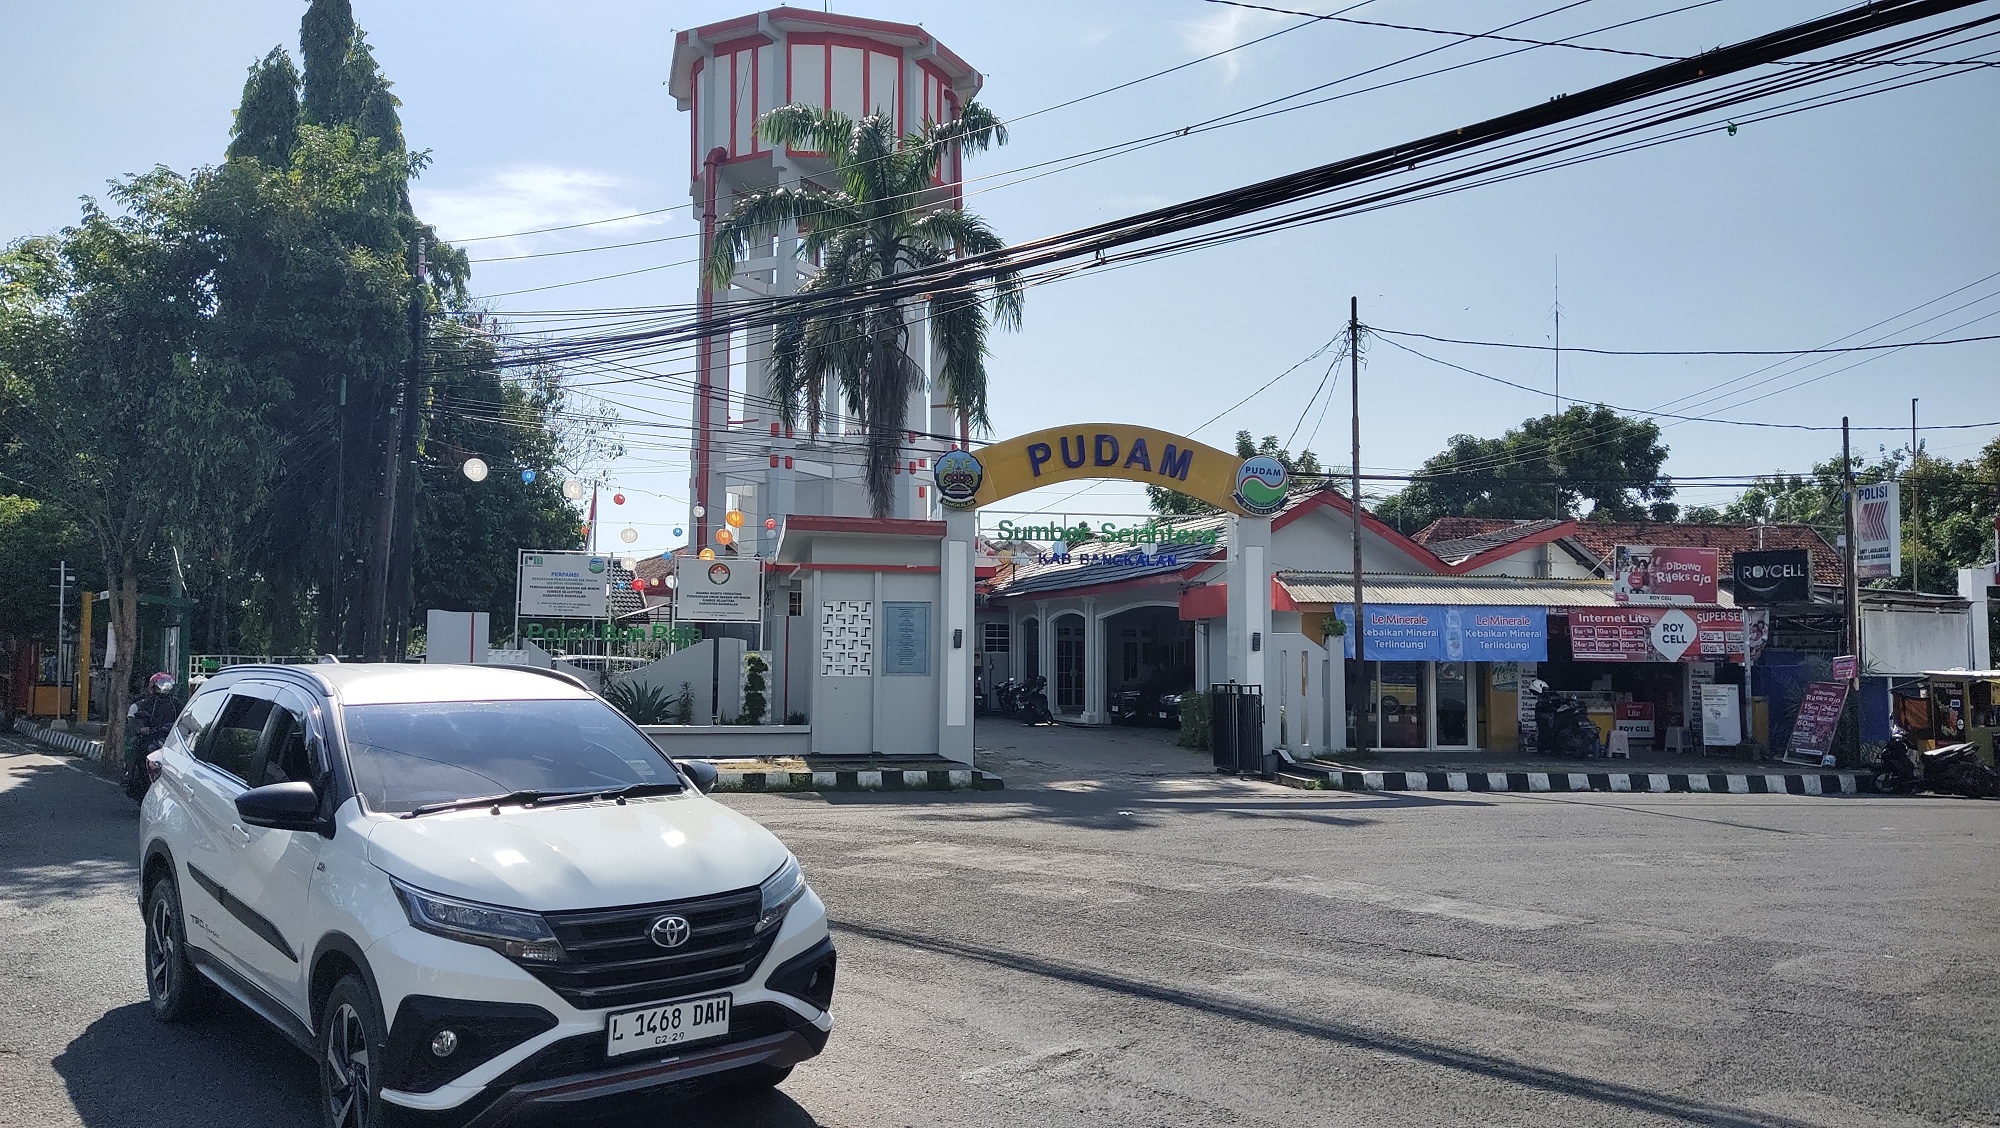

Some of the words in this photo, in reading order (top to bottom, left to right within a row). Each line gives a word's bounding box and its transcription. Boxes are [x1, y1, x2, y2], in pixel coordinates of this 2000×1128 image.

[1027, 434, 1193, 481] PUDAM
[1245, 466, 1281, 476] PUDAM
[1858, 485, 1888, 501] POLISI
[1242, 502, 1281, 515] BANGKALAN
[998, 519, 1091, 542] Sumber
[1101, 521, 1217, 547] Sejahtera
[1038, 552, 1071, 565] KAB
[1079, 553, 1178, 566] BANGKALAN
[1666, 561, 1702, 572] Dibawa
[1656, 571, 1691, 584] Rileks
[1692, 574, 1712, 587] aja
[1371, 612, 1384, 626] Le
[1385, 614, 1428, 626] Minerale
[1476, 614, 1488, 626] Le
[1489, 614, 1531, 626] Minerale
[1578, 613, 1626, 623] Internet
[1628, 614, 1650, 623] Lite
[1696, 612, 1727, 624] SUPER
[1406, 628, 1439, 637] Mineral
[1465, 630, 1508, 638] Kebaikan
[1510, 630, 1542, 638] Mineral
[1662, 623, 1685, 633] ROY
[1374, 640, 1427, 650] Terlindungi
[1662, 634, 1688, 644] CELL
[1479, 641, 1530, 650] Terlindungi
[612, 1018, 624, 1041] L
[634, 1008, 682, 1036] 1468
[692, 1000, 726, 1026] DAH
